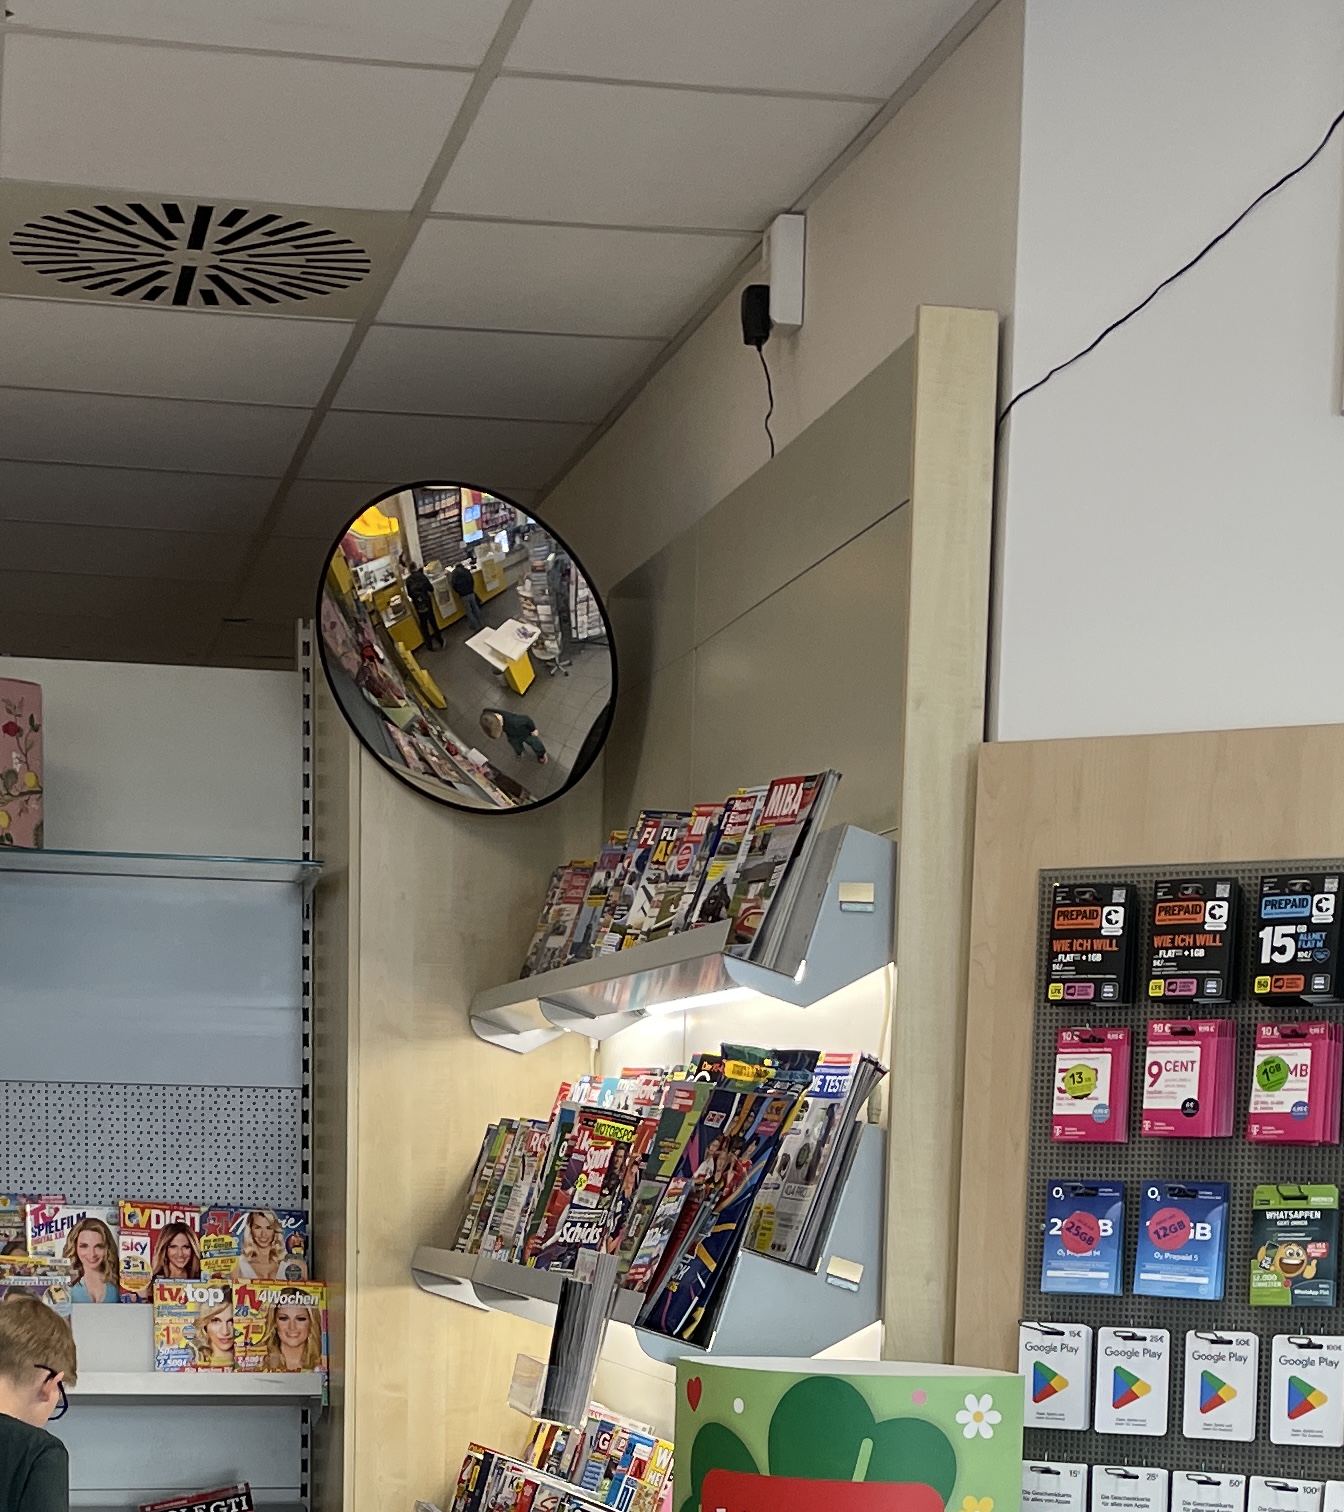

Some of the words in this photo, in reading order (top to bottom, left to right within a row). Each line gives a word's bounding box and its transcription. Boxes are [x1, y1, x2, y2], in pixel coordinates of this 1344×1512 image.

[1263, 898, 1309, 911] PREPAID
[1057, 909, 1099, 921] PREPAID
[1053, 939, 1071, 952] WIE
[1073, 939, 1090, 951] ICH
[1092, 939, 1119, 951] WILL
[1258, 925, 1297, 964] 15
[1164, 1059, 1197, 1074] CENT
[1265, 1210, 1321, 1221] WHATSAPPEN
[1024, 1342, 1058, 1356] Google
[1059, 1342, 1080, 1355] Play
[1104, 1347, 1139, 1361] Google
[1141, 1348, 1163, 1360] Play
